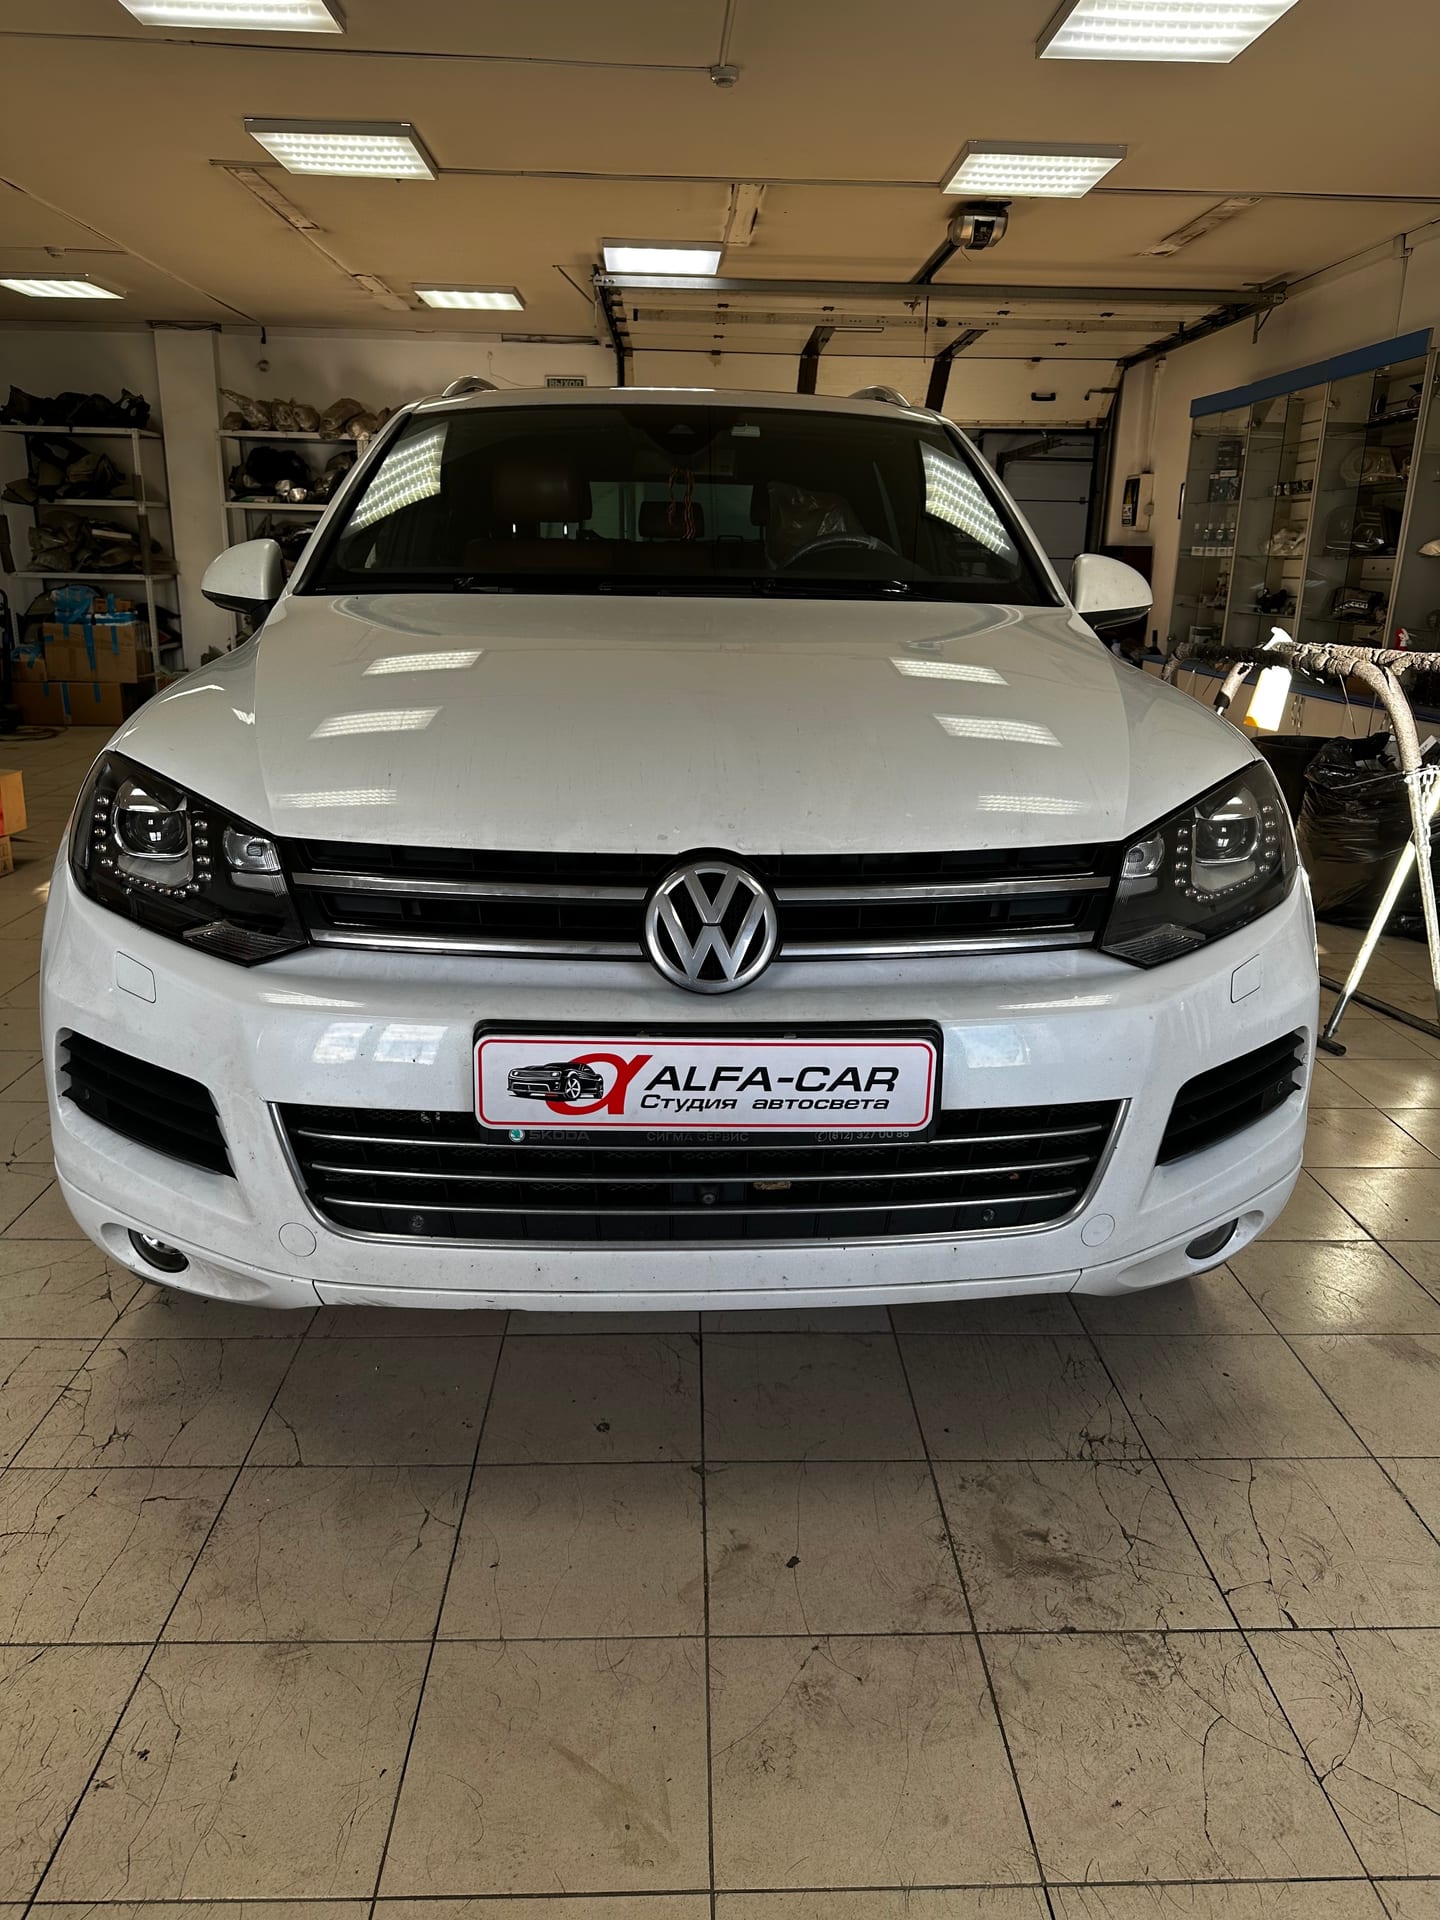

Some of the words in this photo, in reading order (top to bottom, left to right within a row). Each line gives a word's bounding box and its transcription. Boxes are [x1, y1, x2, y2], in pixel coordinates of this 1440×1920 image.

[644, 1066, 900, 1092] ALFA-CAR
[640, 1094, 738, 1112] Студия
[752, 1098, 890, 1110] автосвета
[646, 1131, 694, 1142] СИГМА
[698, 1131, 750, 1142] СЕРВИС
